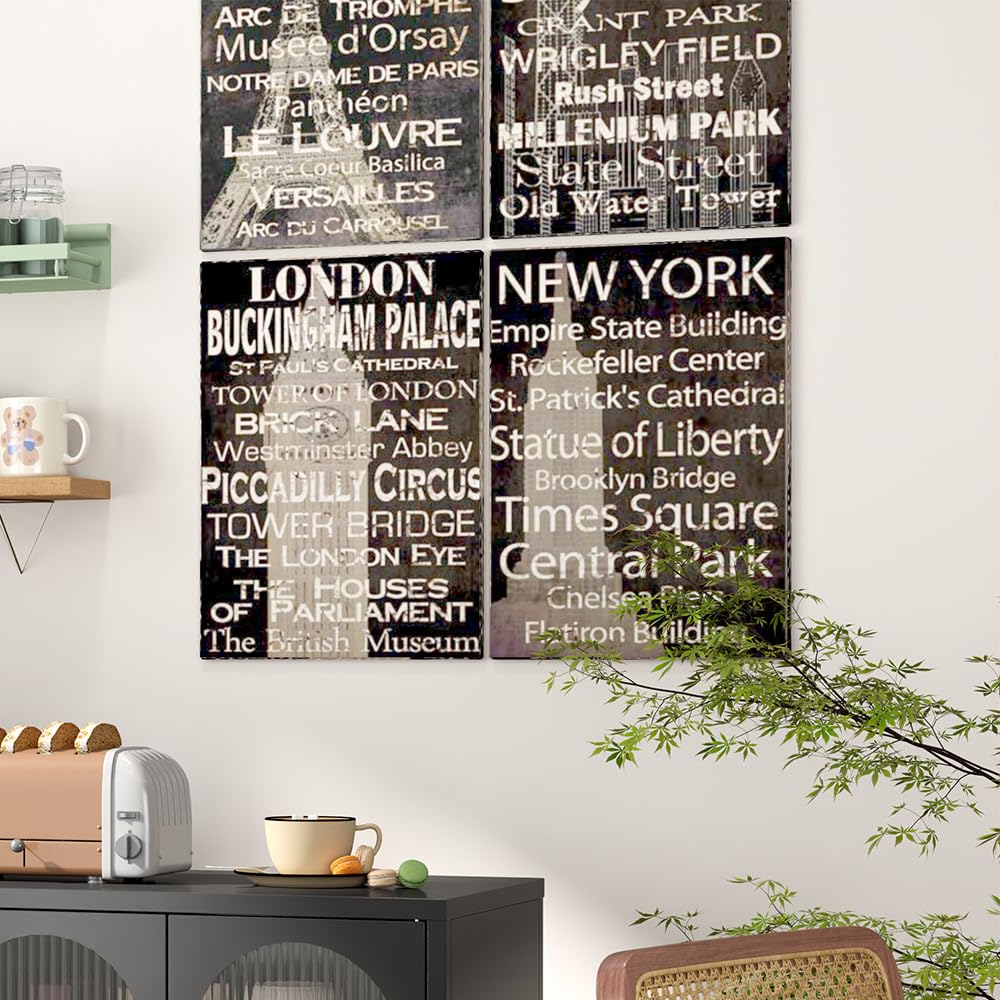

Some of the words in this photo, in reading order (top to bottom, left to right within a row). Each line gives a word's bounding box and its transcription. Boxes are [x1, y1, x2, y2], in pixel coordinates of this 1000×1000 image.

[214, 6, 272, 29] ARC
[284, 2, 320, 24] DE
[329, 0, 472, 21] TRIOMPHE
[517, 10, 650, 36] GRANT
[665, 3, 763, 27] PARK
[338, 23, 469, 56] d'Orsay
[500, 39, 665, 75] WRIGLEY
[677, 32, 782, 64] FIELD
[207, 72, 286, 93] NOTRE
[294, 67, 362, 88] DAME
[369, 64, 401, 83] DE
[408, 60, 480, 81] PARIS
[555, 79, 625, 105] Rush
[633, 72, 724, 101] Street
[222, 126, 278, 158] LE
[293, 118, 463, 153] LOUVRE
[498, 113, 678, 150] MILLENIUM
[690, 107, 783, 140] PARK
[301, 158, 362, 177] Coeur
[369, 153, 446, 173] Basilica
[516, 151, 623, 188] State
[638, 145, 765, 181] Street
[250, 181, 435, 210] VERSAILLES
[499, 192, 560, 220] Old
[569, 188, 662, 215] Water
[675, 183, 782, 211] Tower
[236, 222, 280, 239] ARC
[287, 220, 316, 236] DU
[323, 215, 449, 235] CARROUSEL
[249, 259, 436, 302] LONDON
[498, 260, 619, 305] NEW
[629, 253, 775, 300] YORK
[207, 303, 376, 357] BUCKINGHAM
[385, 299, 481, 351] PALACE
[490, 318, 584, 349] Empire
[590, 315, 662, 340] State
[669, 309, 787, 341] Building
[229, 360, 255, 376] ST
[332, 356, 459, 373] CATHEDRAL
[510, 349, 663, 377] Rockefeller
[669, 348, 765, 373] Center
[211, 384, 306, 406] TOWER
[311, 382, 349, 403] OF
[355, 379, 478, 402] LONDON
[490, 388, 523, 413] St.
[530, 383, 640, 411] Patrick's
[646, 379, 785, 407] Cathedral
[235, 410, 337, 436] BRICK
[354, 407, 449, 432] LANE
[213, 439, 385, 462] Westminster
[392, 436, 473, 465] Abbey
[490, 425, 602, 461] Statue
[611, 420, 650, 458] of
[656, 419, 784, 466] Liberty
[201, 466, 367, 505] PICCADILLY
[374, 463, 481, 502] CIRCUS
[535, 468, 645, 495] Brooklyn
[652, 466, 737, 493] Bridge
[207, 513, 334, 540] TOWER
[347, 510, 476, 538] BRIDGE
[495, 496, 619, 533] Times
[630, 493, 779, 541] Square
[215, 546, 271, 568] THE
[282, 545, 400, 567] LONDON
[411, 543, 467, 567] EYE
[500, 541, 658, 580] Central
[674, 538, 774, 579] Park
[233, 579, 296, 600] THE
[314, 576, 449, 600] HOUSES
[210, 602, 252, 624] OF
[271, 600, 474, 623] PARLIAMENT
[204, 628, 256, 653] The
[363, 628, 481, 653] Museum
